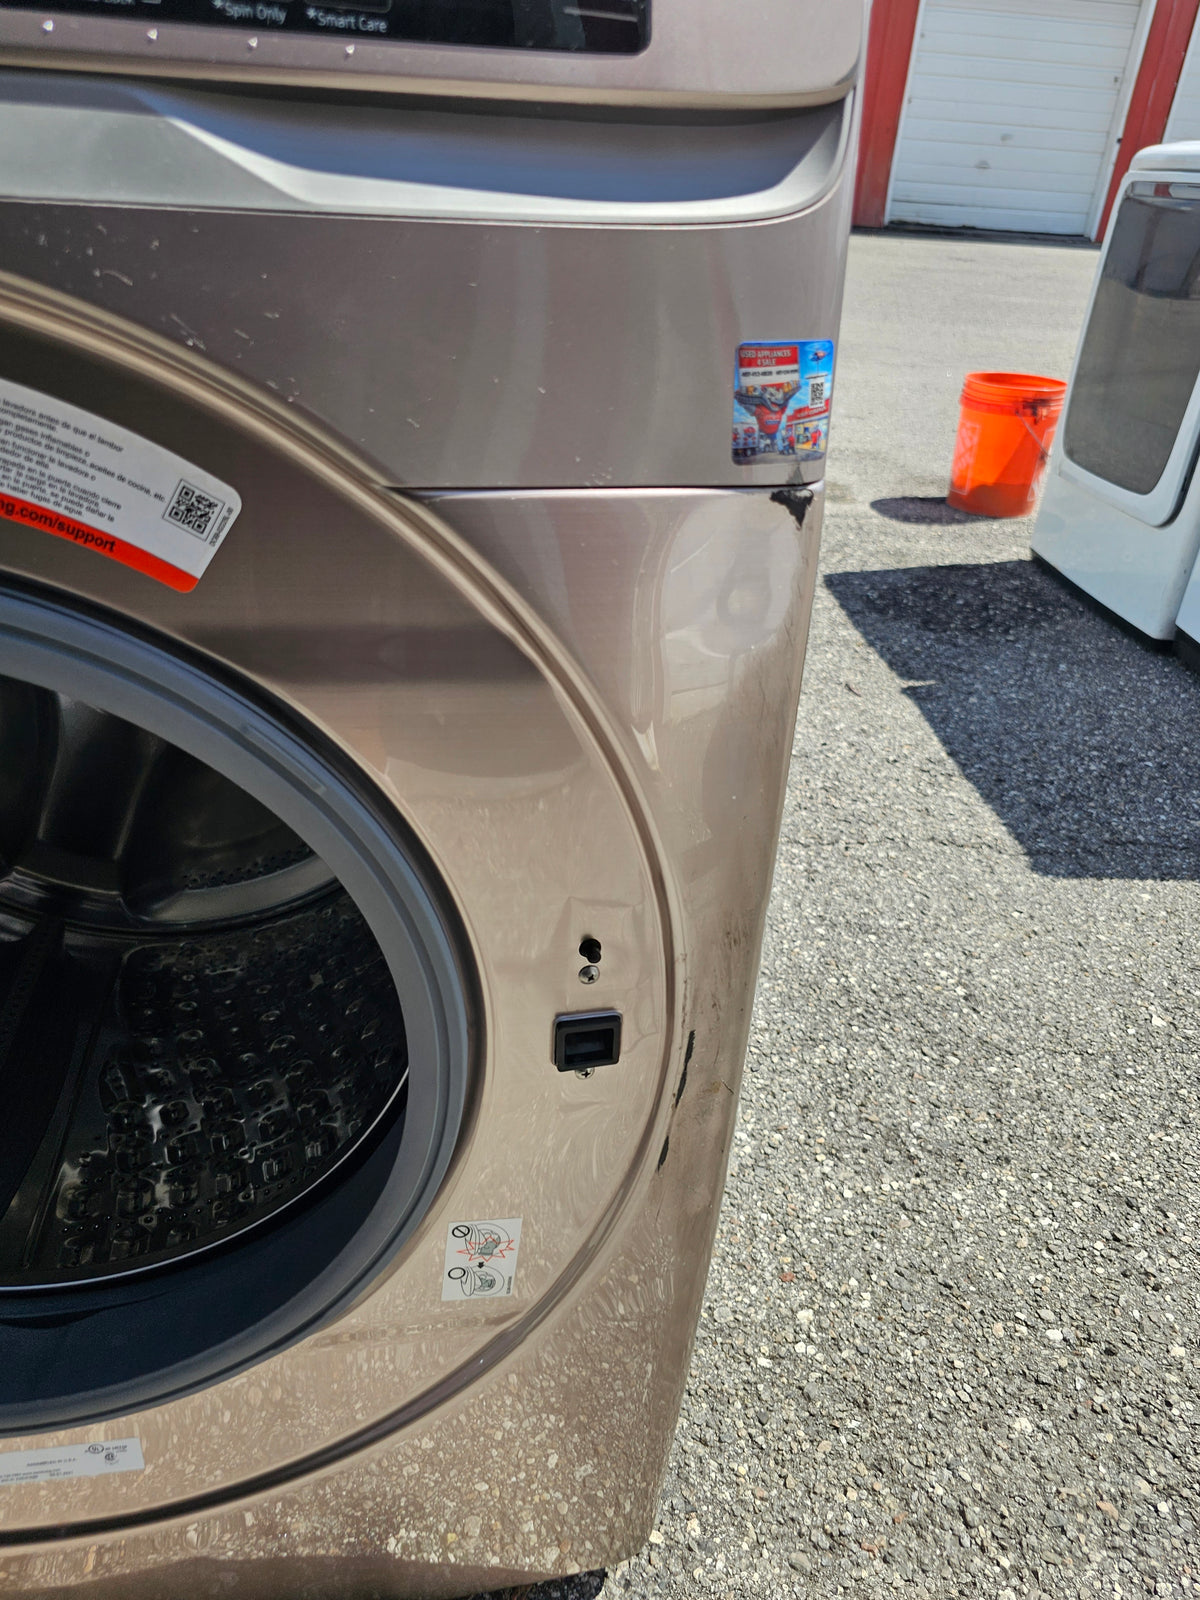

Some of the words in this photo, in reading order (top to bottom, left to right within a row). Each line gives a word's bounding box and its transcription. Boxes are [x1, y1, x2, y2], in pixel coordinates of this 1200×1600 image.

[256, 4, 288, 25] Only
[358, 17, 388, 33] Care
[757, 349, 792, 358] APPLIANCES
[3, 398, 36, 416] lavadora
[39, 412, 60, 425] antes
[61, 421, 71, 430] de
[73, 426, 88, 438] que
[98, 436, 124, 452] tambor
[5, 429, 42, 447] productos
[117, 473, 126, 483] de
[24, 455, 33, 463] de
[57, 459, 89, 478] lavadora
[53, 500, 62, 508] de
[61, 495, 84, 509] puede
[73, 484, 100, 501] cuando
[101, 497, 122, 511] cierre
